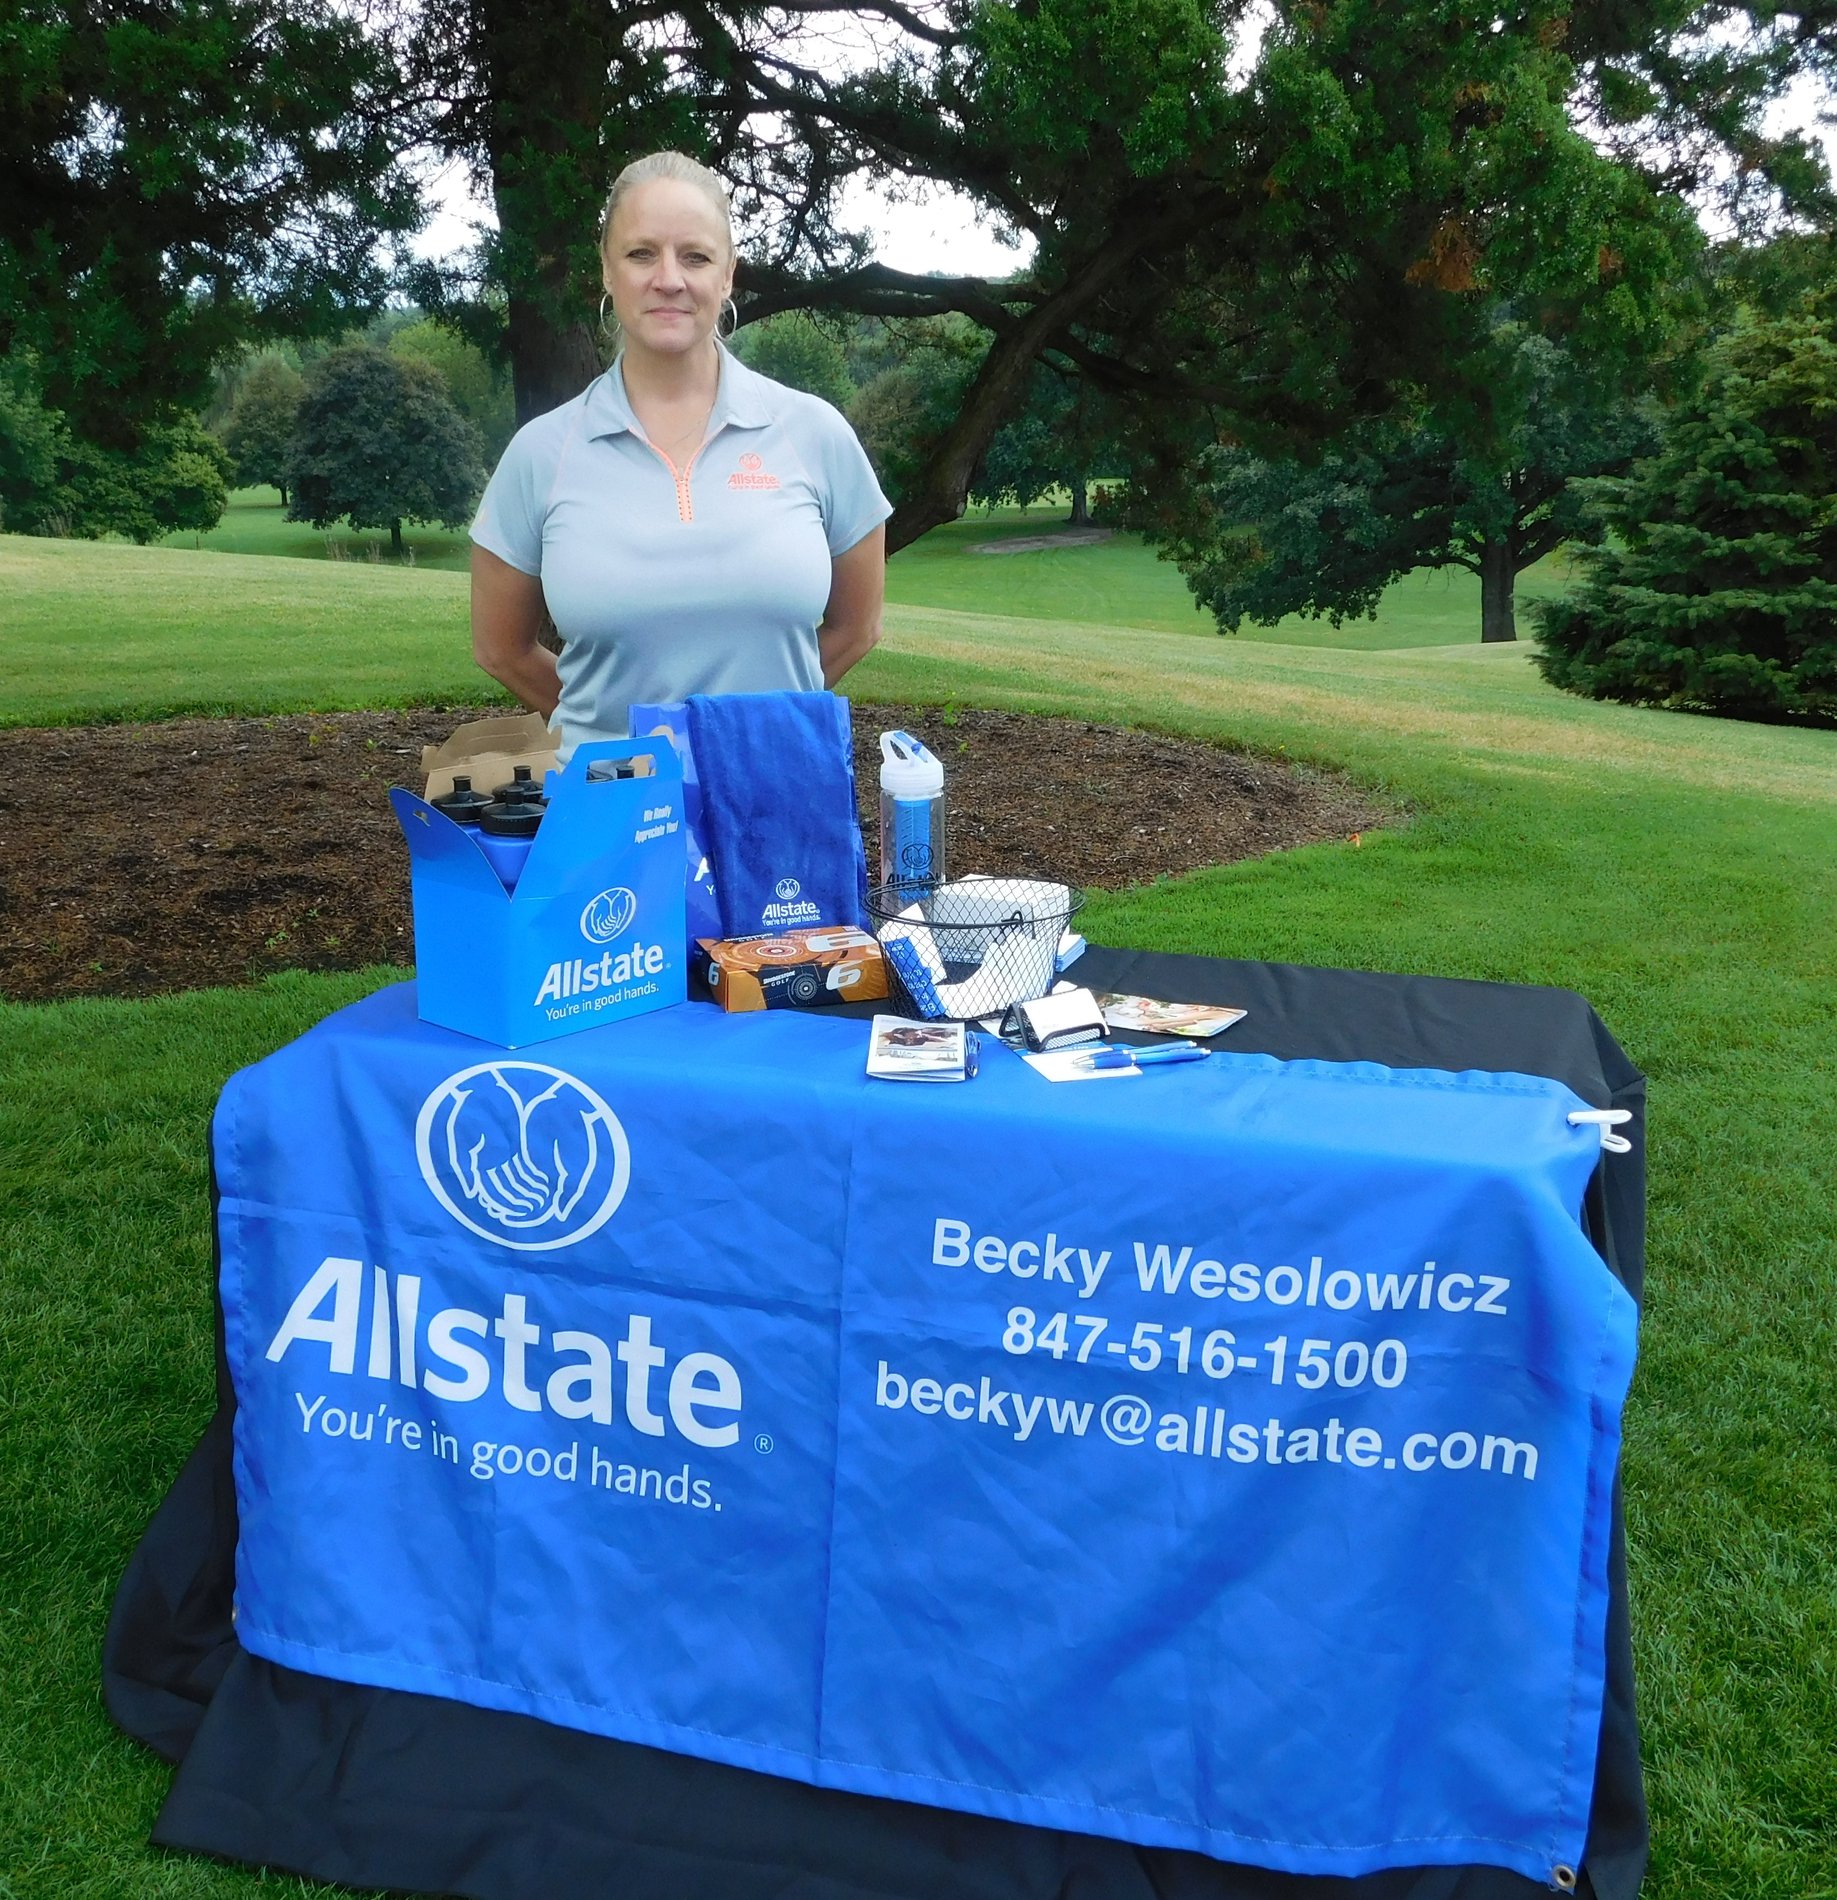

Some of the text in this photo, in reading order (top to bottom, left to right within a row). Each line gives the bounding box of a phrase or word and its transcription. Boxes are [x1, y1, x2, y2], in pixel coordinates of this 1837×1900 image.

[728, 473, 777, 485] Allstate
[762, 900, 817, 919] Allstate
[787, 915, 802, 925] good
[533, 942, 664, 1006] Allstate
[545, 980, 660, 1021] You're in good hands.
[931, 1217, 1511, 1315] Becky Wesolowicz
[265, 1256, 742, 1449] Allstate
[1001, 1306, 1408, 1390] 847-516-1500
[294, 1391, 722, 1512] You're in good hands.
[875, 1361, 1540, 1481] beckyw@allstate.com
